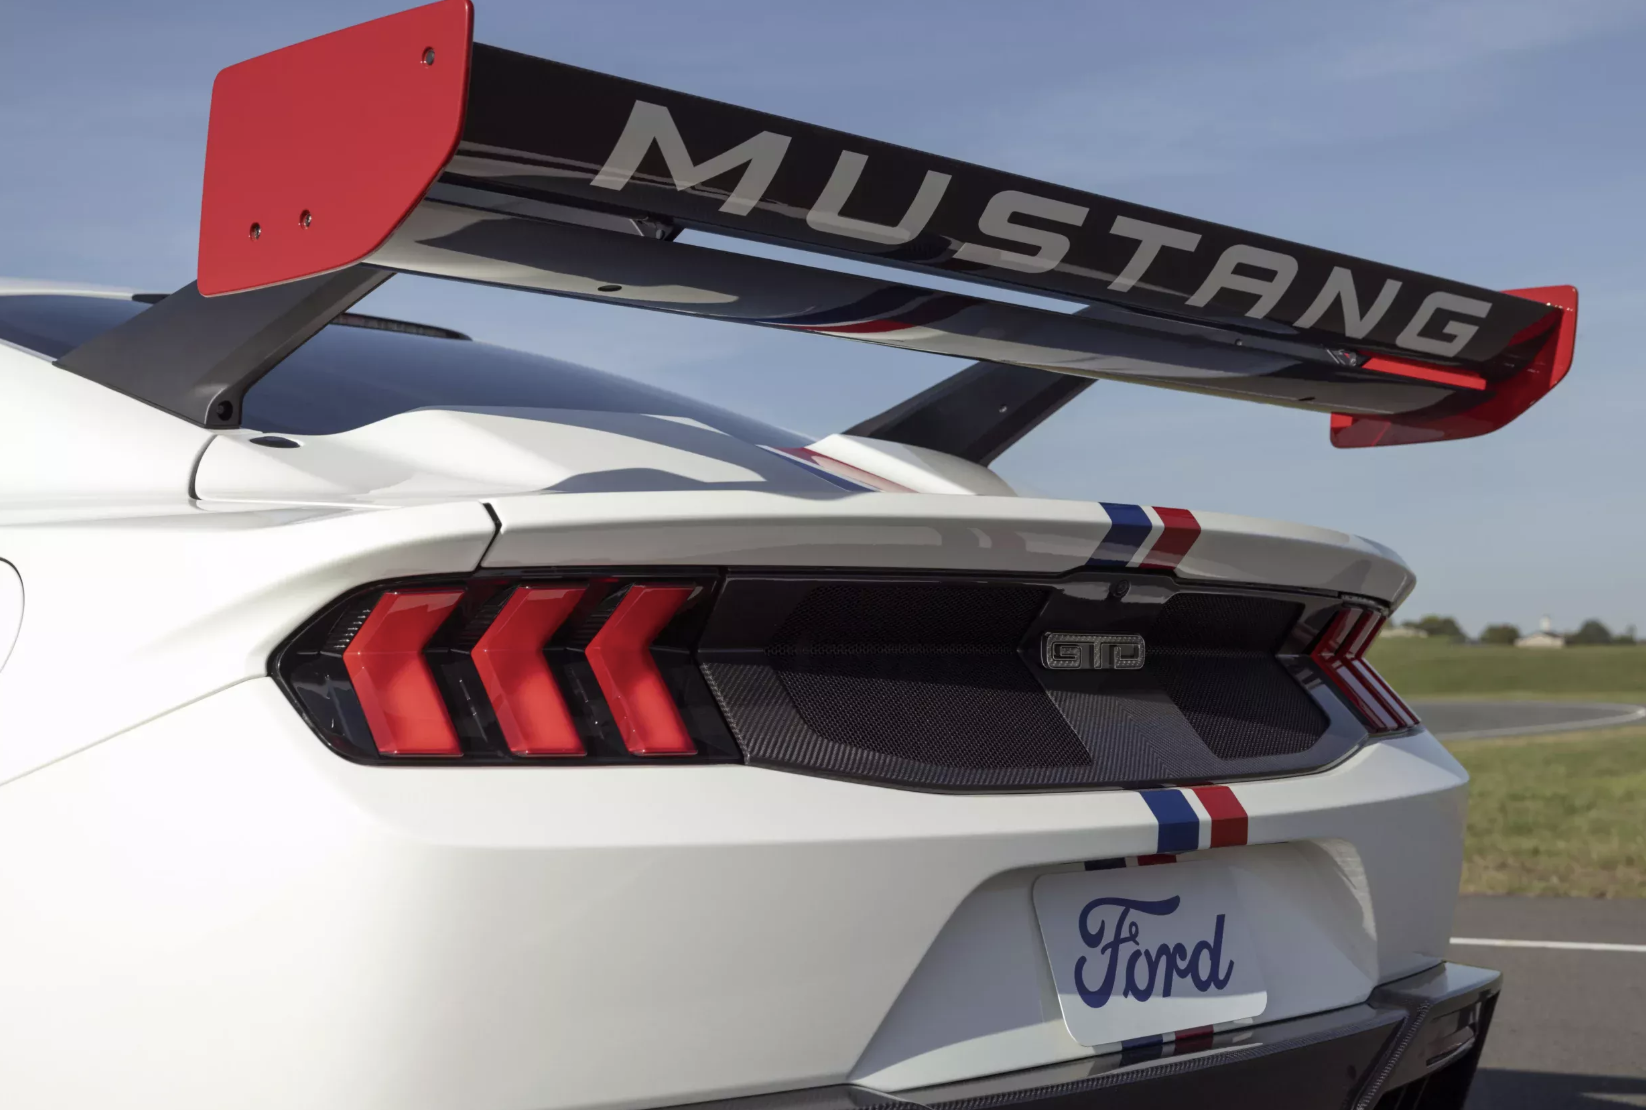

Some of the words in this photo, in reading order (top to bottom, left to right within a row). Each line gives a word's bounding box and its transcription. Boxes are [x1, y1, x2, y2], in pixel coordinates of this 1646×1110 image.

[590, 100, 1493, 358] MUSTANG
[1042, 632, 1145, 670] GTD
[1074, 895, 1235, 1009] Ford
